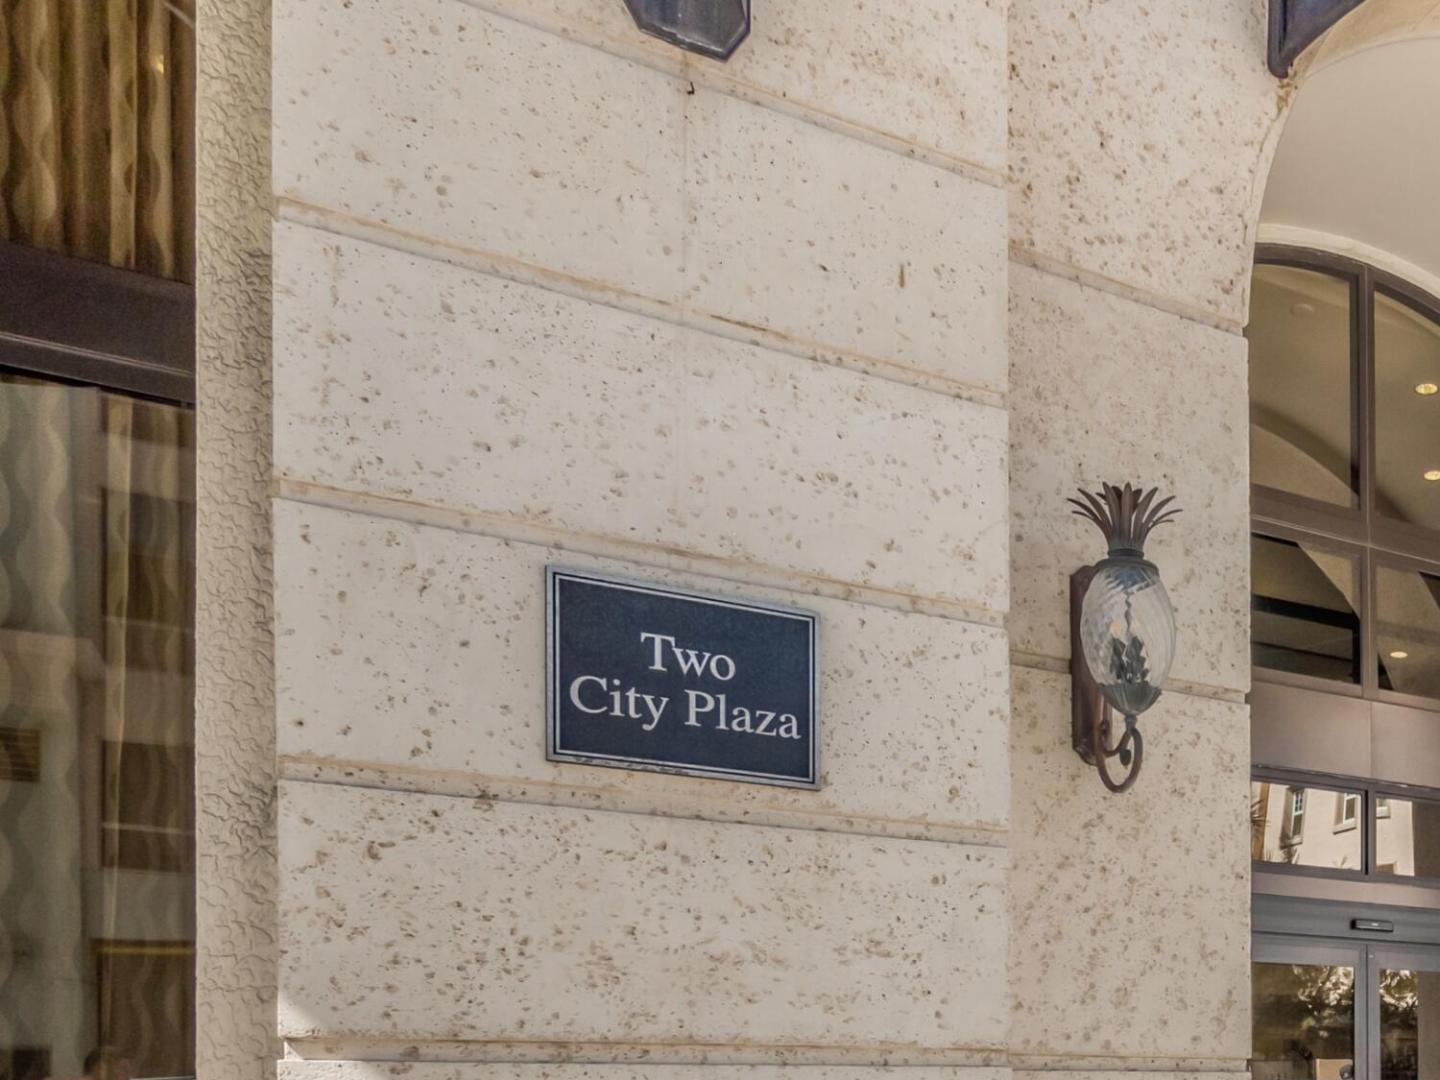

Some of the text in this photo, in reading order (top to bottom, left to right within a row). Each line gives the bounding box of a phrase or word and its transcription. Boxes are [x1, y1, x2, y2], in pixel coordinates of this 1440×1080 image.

[640, 631, 736, 681] Two
[569, 675, 801, 740] City Plaza
